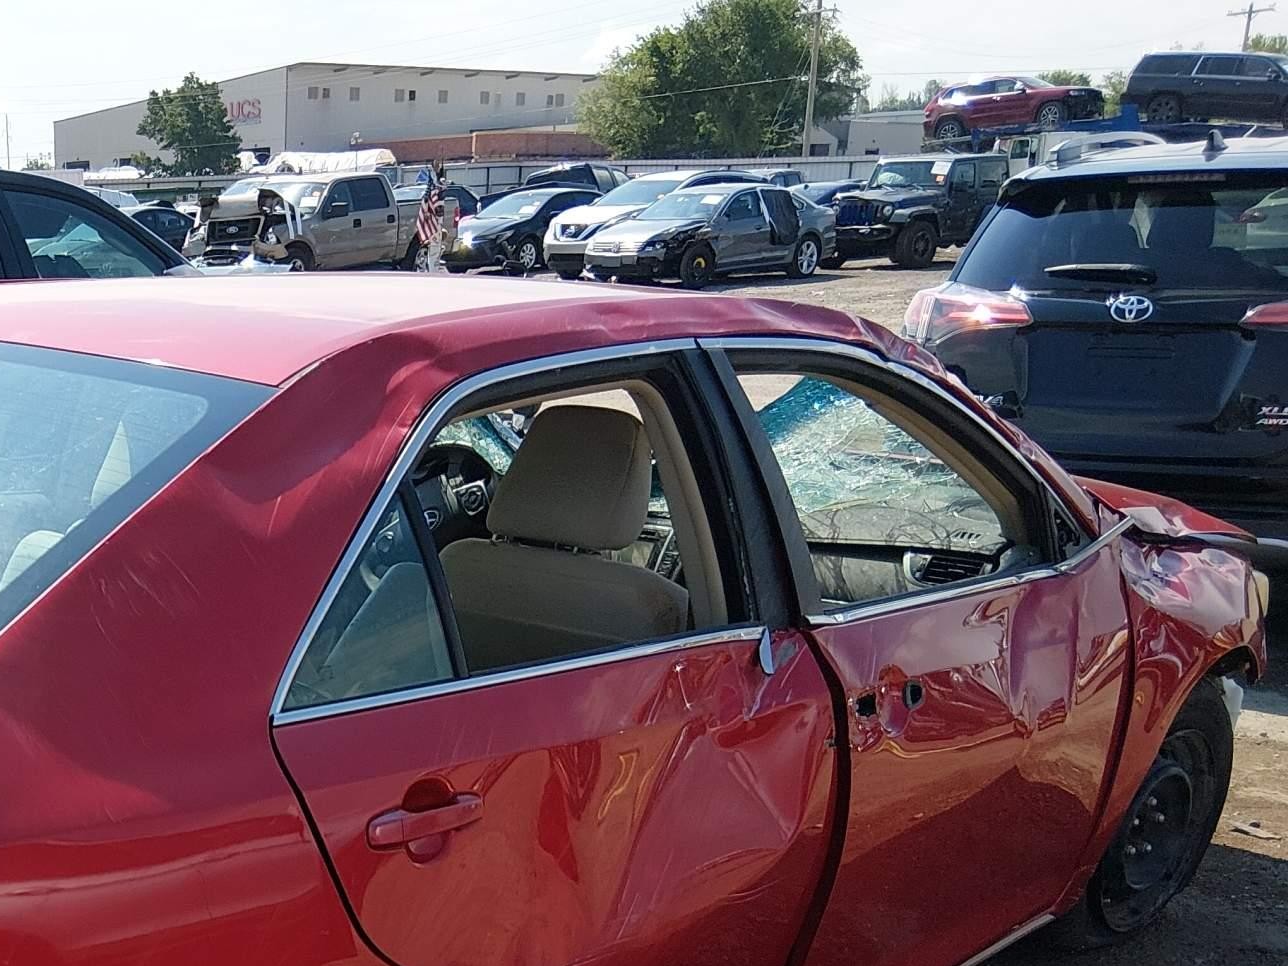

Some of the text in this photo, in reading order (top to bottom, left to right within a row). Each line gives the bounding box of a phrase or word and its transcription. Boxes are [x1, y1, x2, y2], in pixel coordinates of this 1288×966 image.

[228, 99, 262, 119] UCS
[973, 394, 1004, 406] V4
[1255, 418, 1288, 426] AWD
